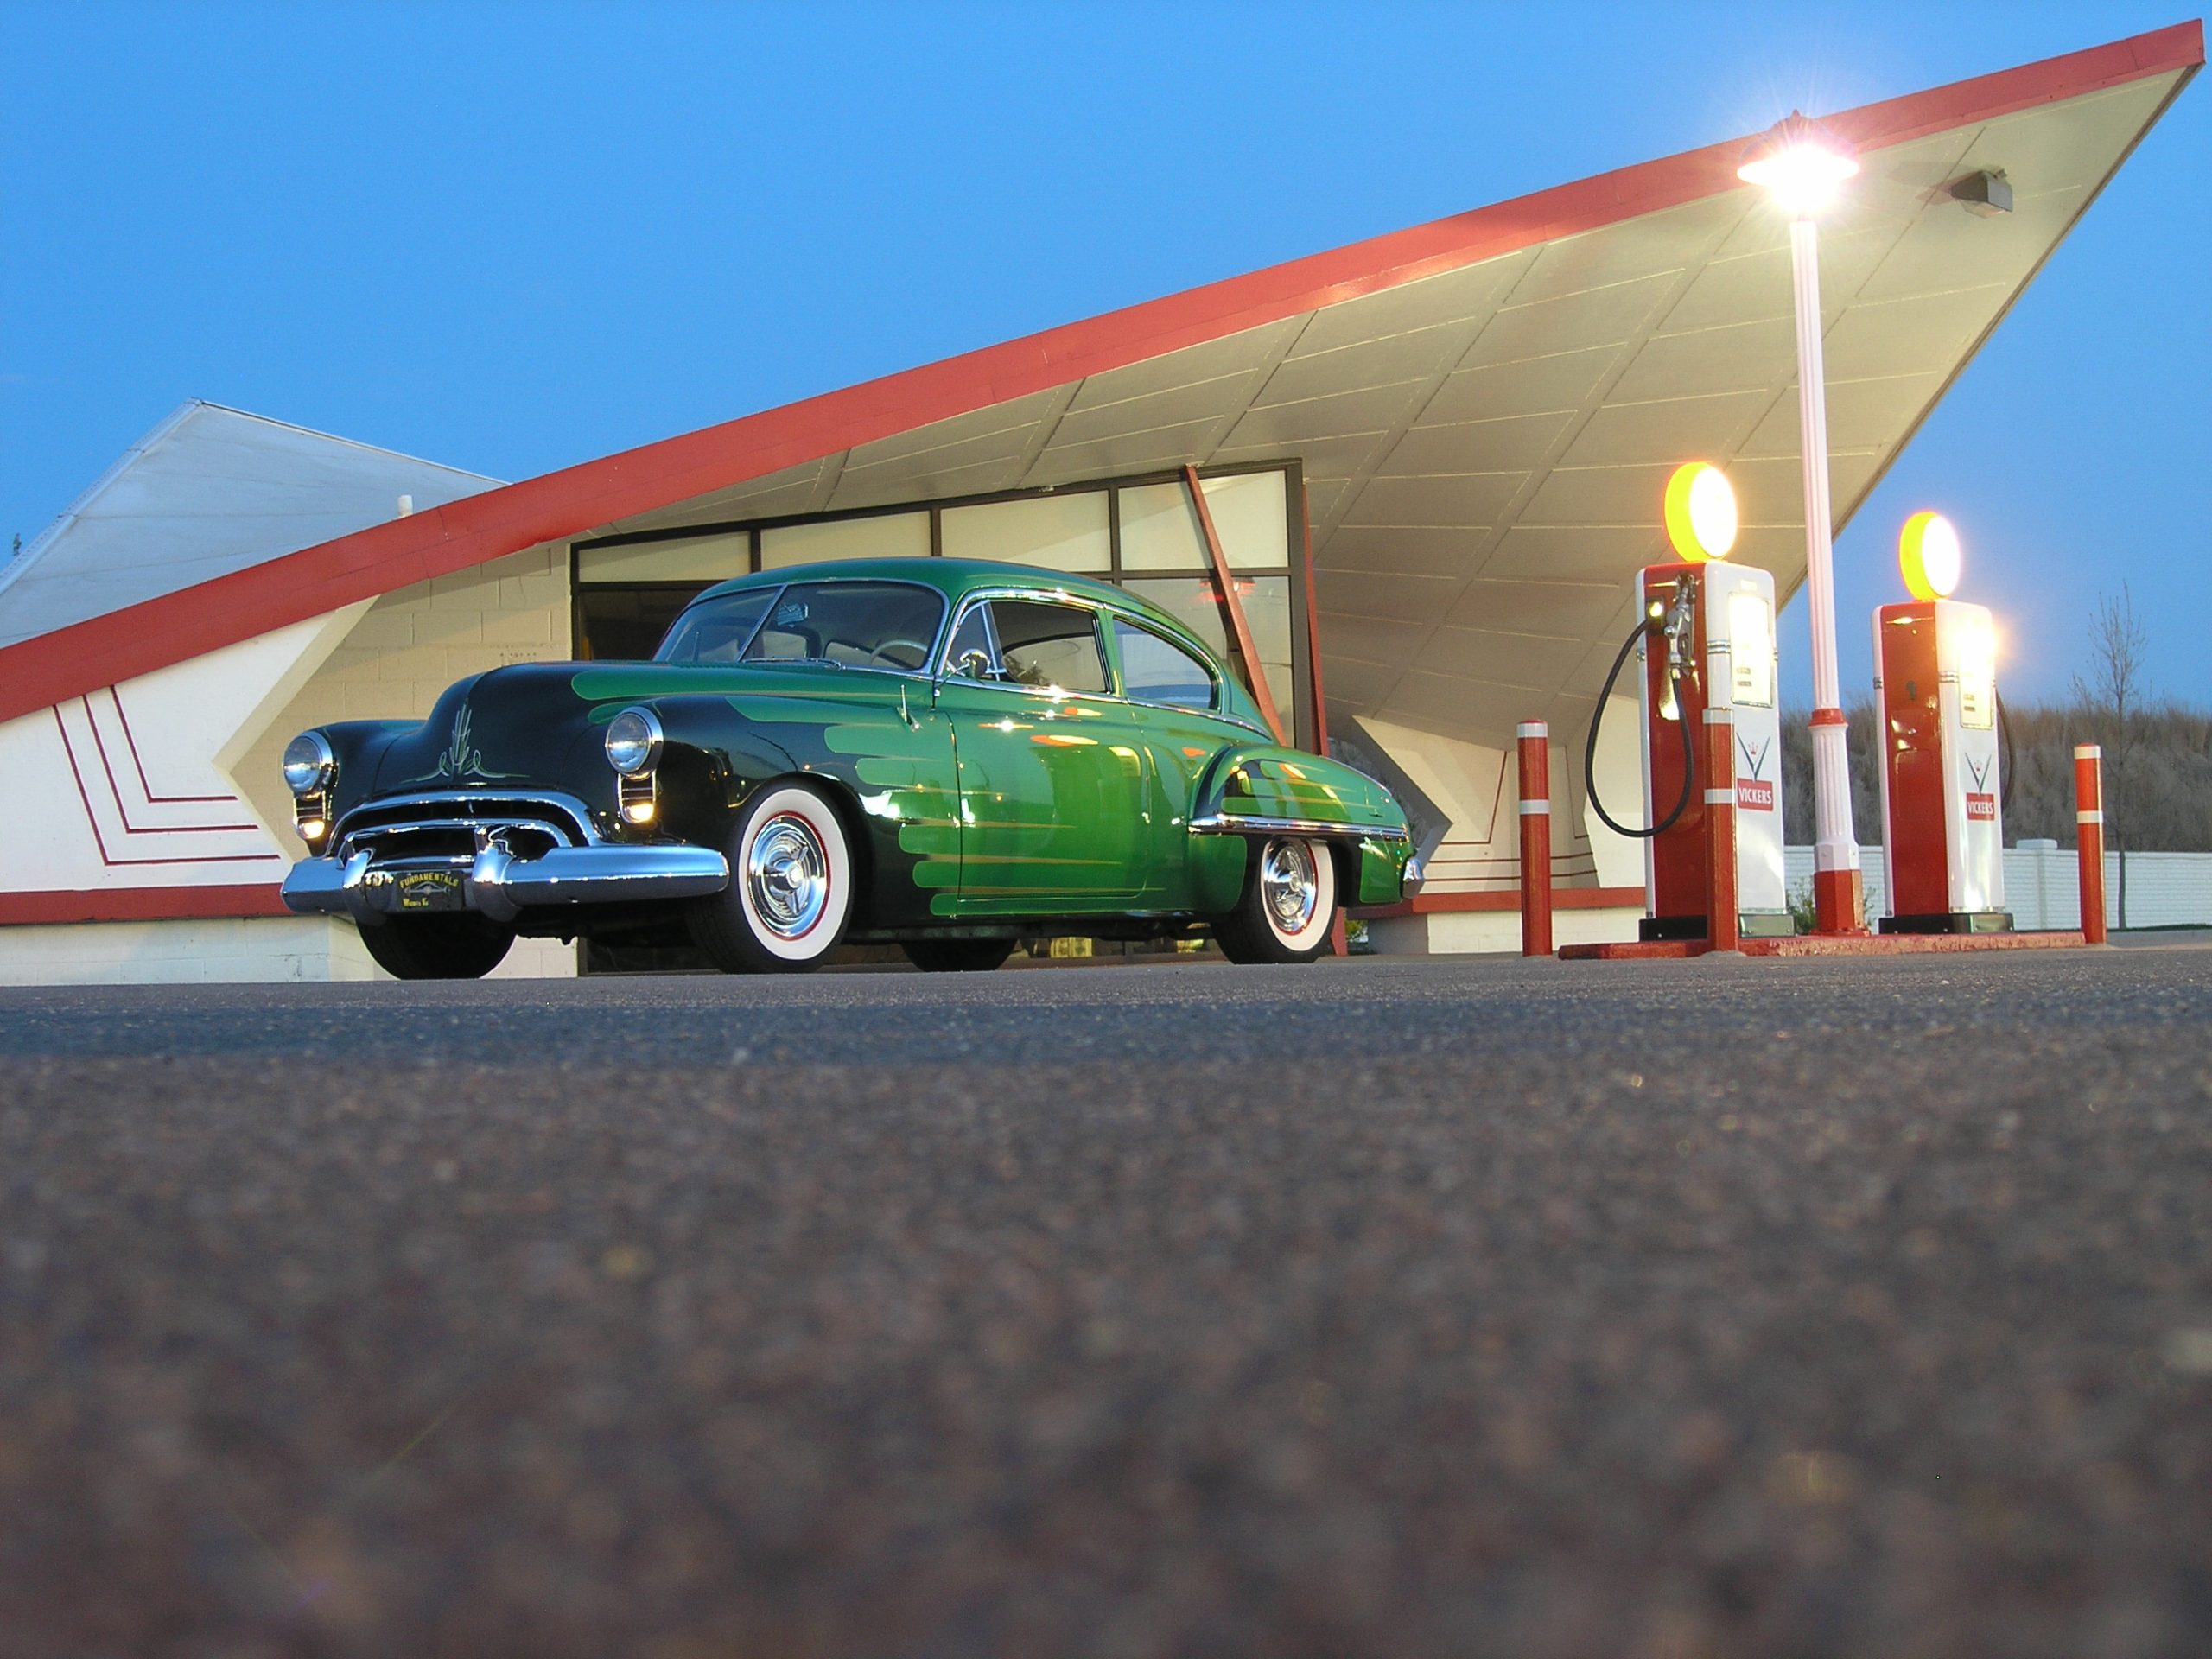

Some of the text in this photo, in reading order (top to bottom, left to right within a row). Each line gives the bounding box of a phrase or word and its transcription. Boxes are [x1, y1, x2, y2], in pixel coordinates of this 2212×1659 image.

[1738, 787, 1772, 804] VICKERS
[1967, 801, 1993, 815] VICKERS
[400, 873, 459, 889] FUNDAMENTALS
